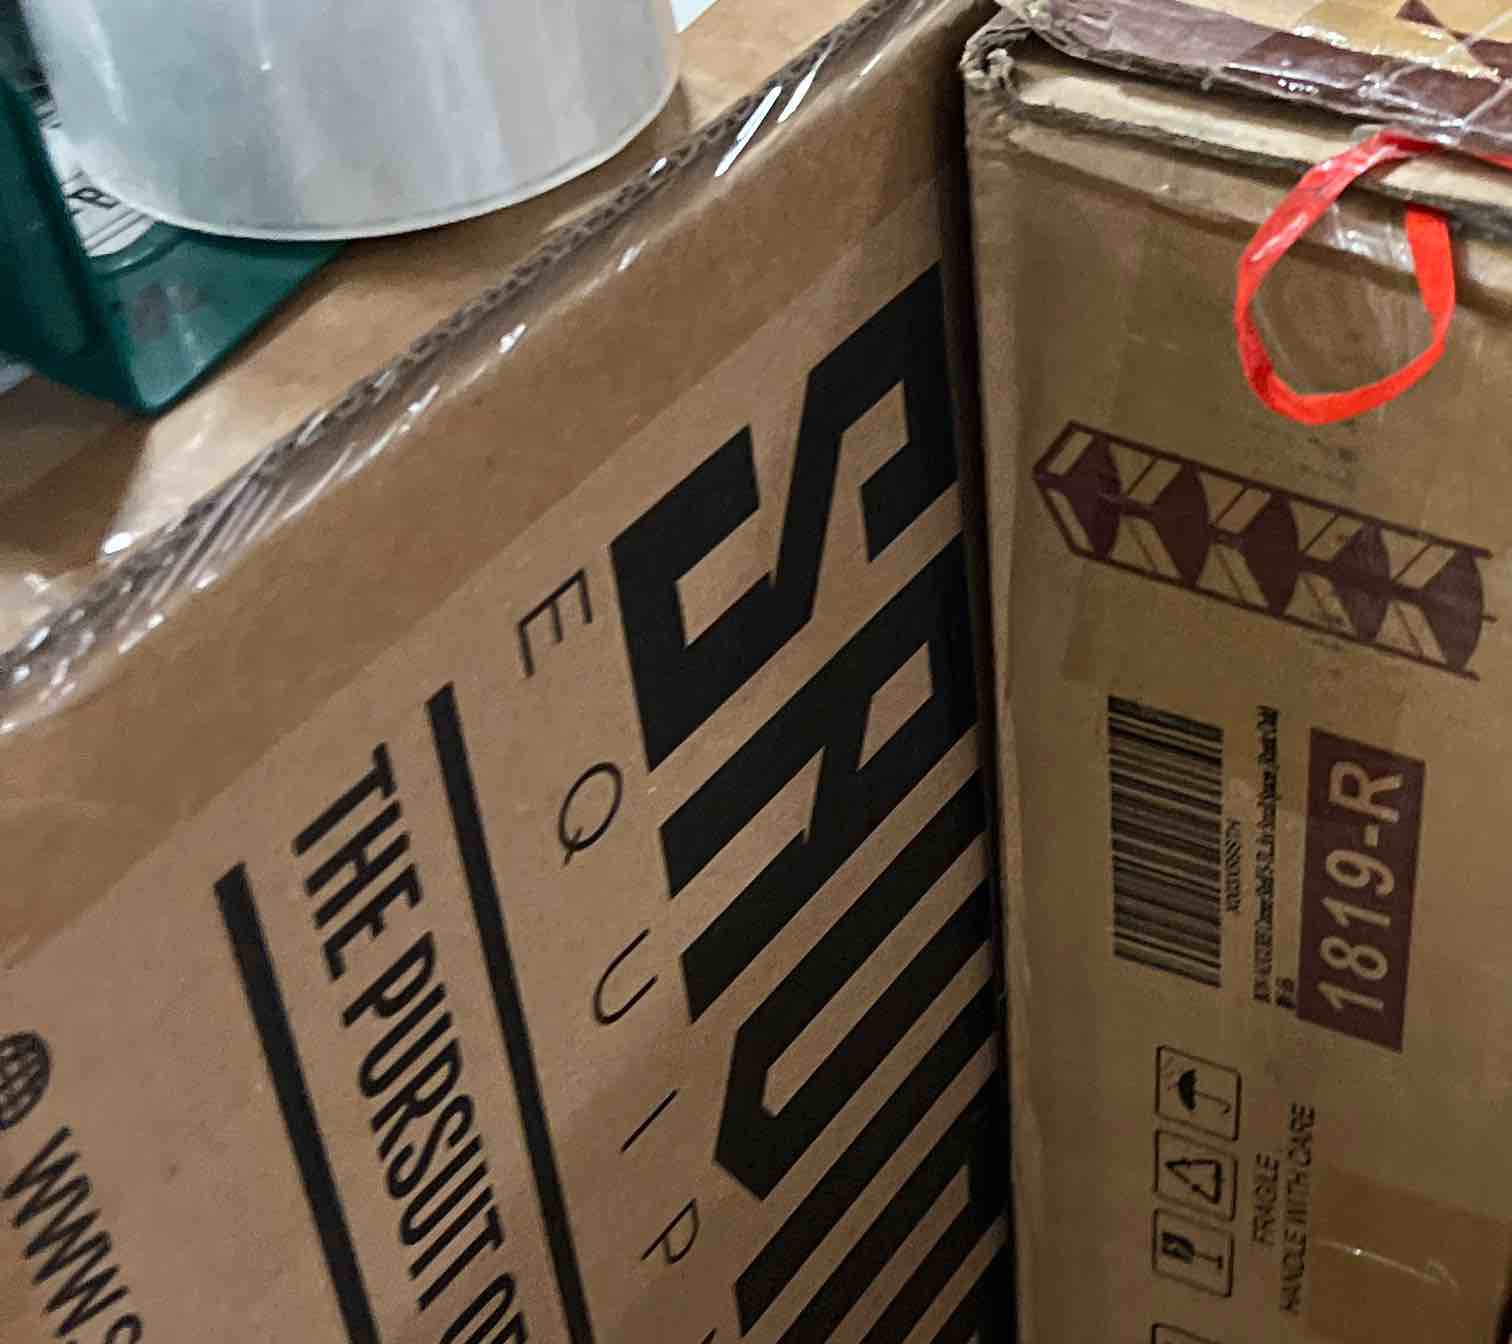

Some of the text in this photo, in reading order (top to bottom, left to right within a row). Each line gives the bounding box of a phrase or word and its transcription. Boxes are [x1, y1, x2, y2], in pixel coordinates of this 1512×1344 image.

[292, 742, 423, 983] THE
[1317, 759, 1402, 1015] 1819-R
[342, 928, 503, 1312] PURSUIT
